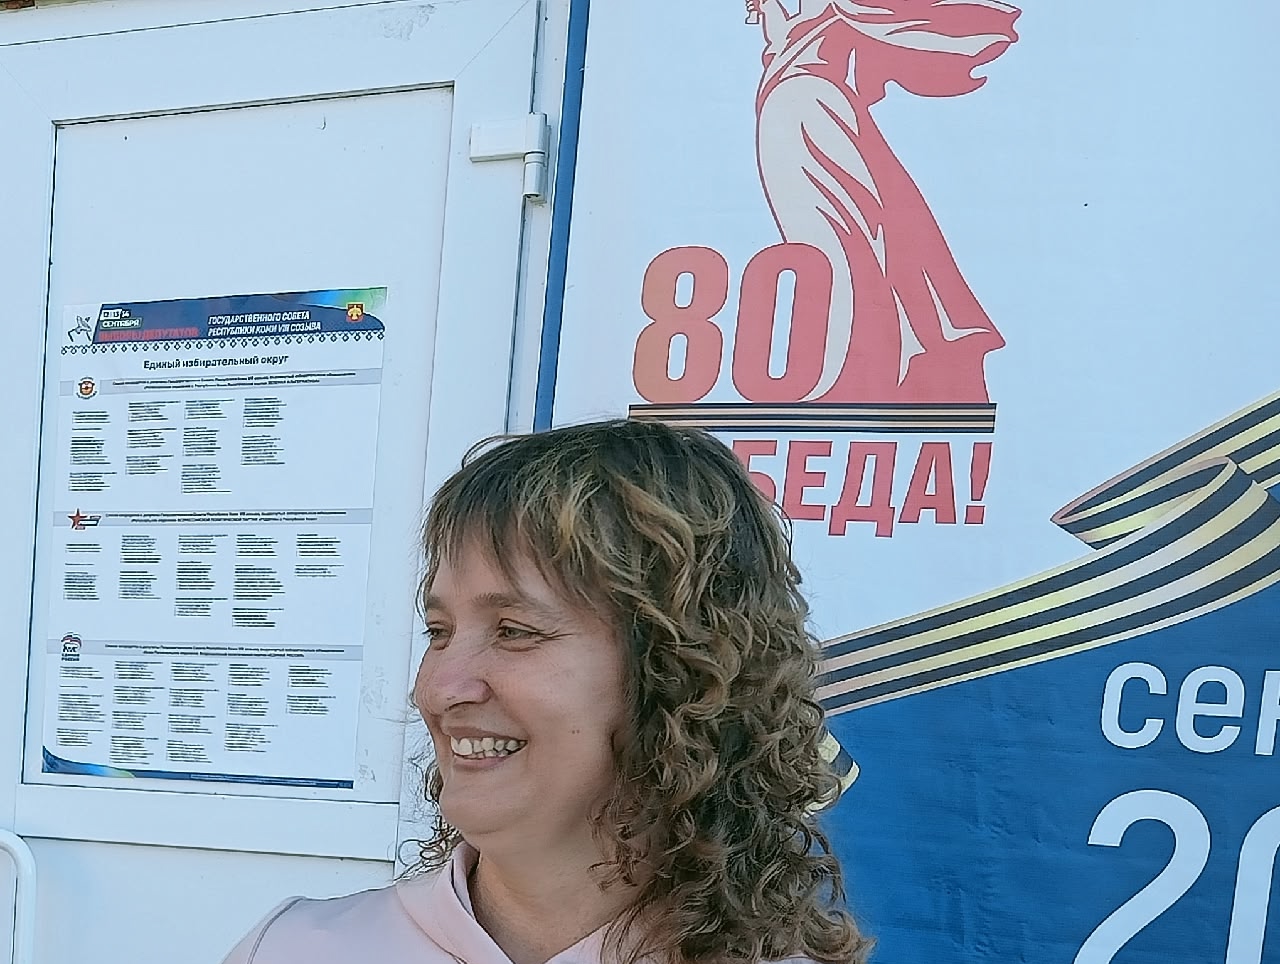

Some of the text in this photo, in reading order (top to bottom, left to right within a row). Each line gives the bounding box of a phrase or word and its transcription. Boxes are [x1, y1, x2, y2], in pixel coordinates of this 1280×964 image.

[143, 355, 289, 370] Единый избирательный округ
[632, 242, 834, 404] 80
[731, 439, 992, 538] БЕДА!
